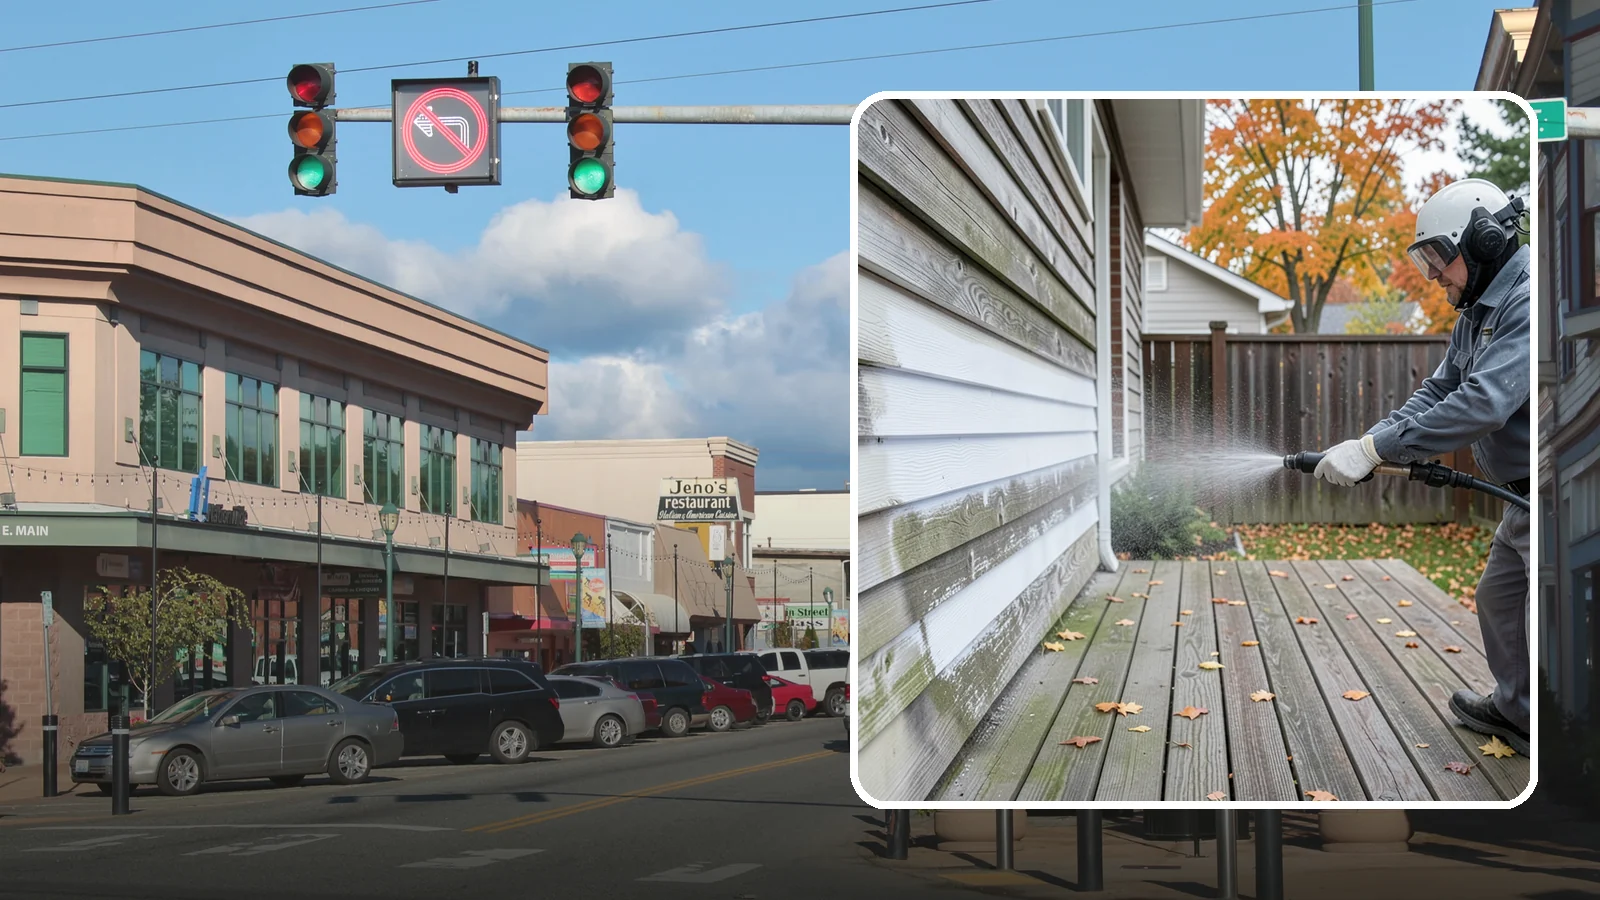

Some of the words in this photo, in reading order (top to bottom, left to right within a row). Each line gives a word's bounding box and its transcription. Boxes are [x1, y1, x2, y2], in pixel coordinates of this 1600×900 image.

[670, 480, 728, 494] Jeno's
[665, 496, 731, 509] restaurant
[658, 510, 682, 519] Italian
[686, 510, 714, 519] American
[715, 509, 738, 519] Cuisine
[2, 525, 13, 536] E.
[15, 525, 49, 536] MAIN
[786, 607, 795, 617] in
[797, 607, 829, 617] Street
[791, 619, 823, 627] lass
